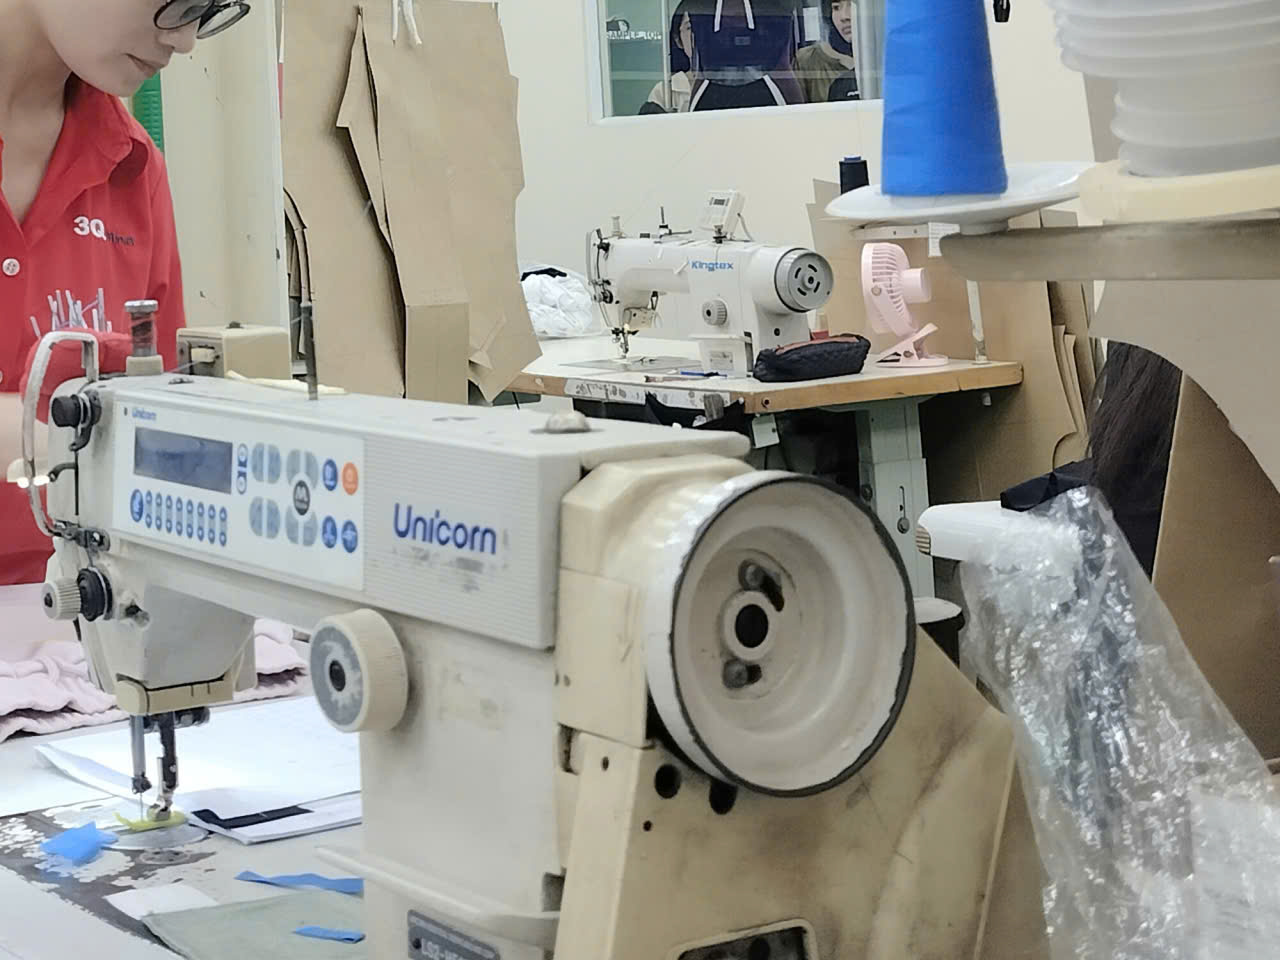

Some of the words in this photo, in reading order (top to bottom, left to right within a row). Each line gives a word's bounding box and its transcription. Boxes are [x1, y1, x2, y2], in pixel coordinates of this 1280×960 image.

[73, 215, 107, 240] 3Q
[691, 260, 734, 272] Kingtex
[131, 409, 157, 421] Unicorn
[393, 502, 497, 555] Unicorn
